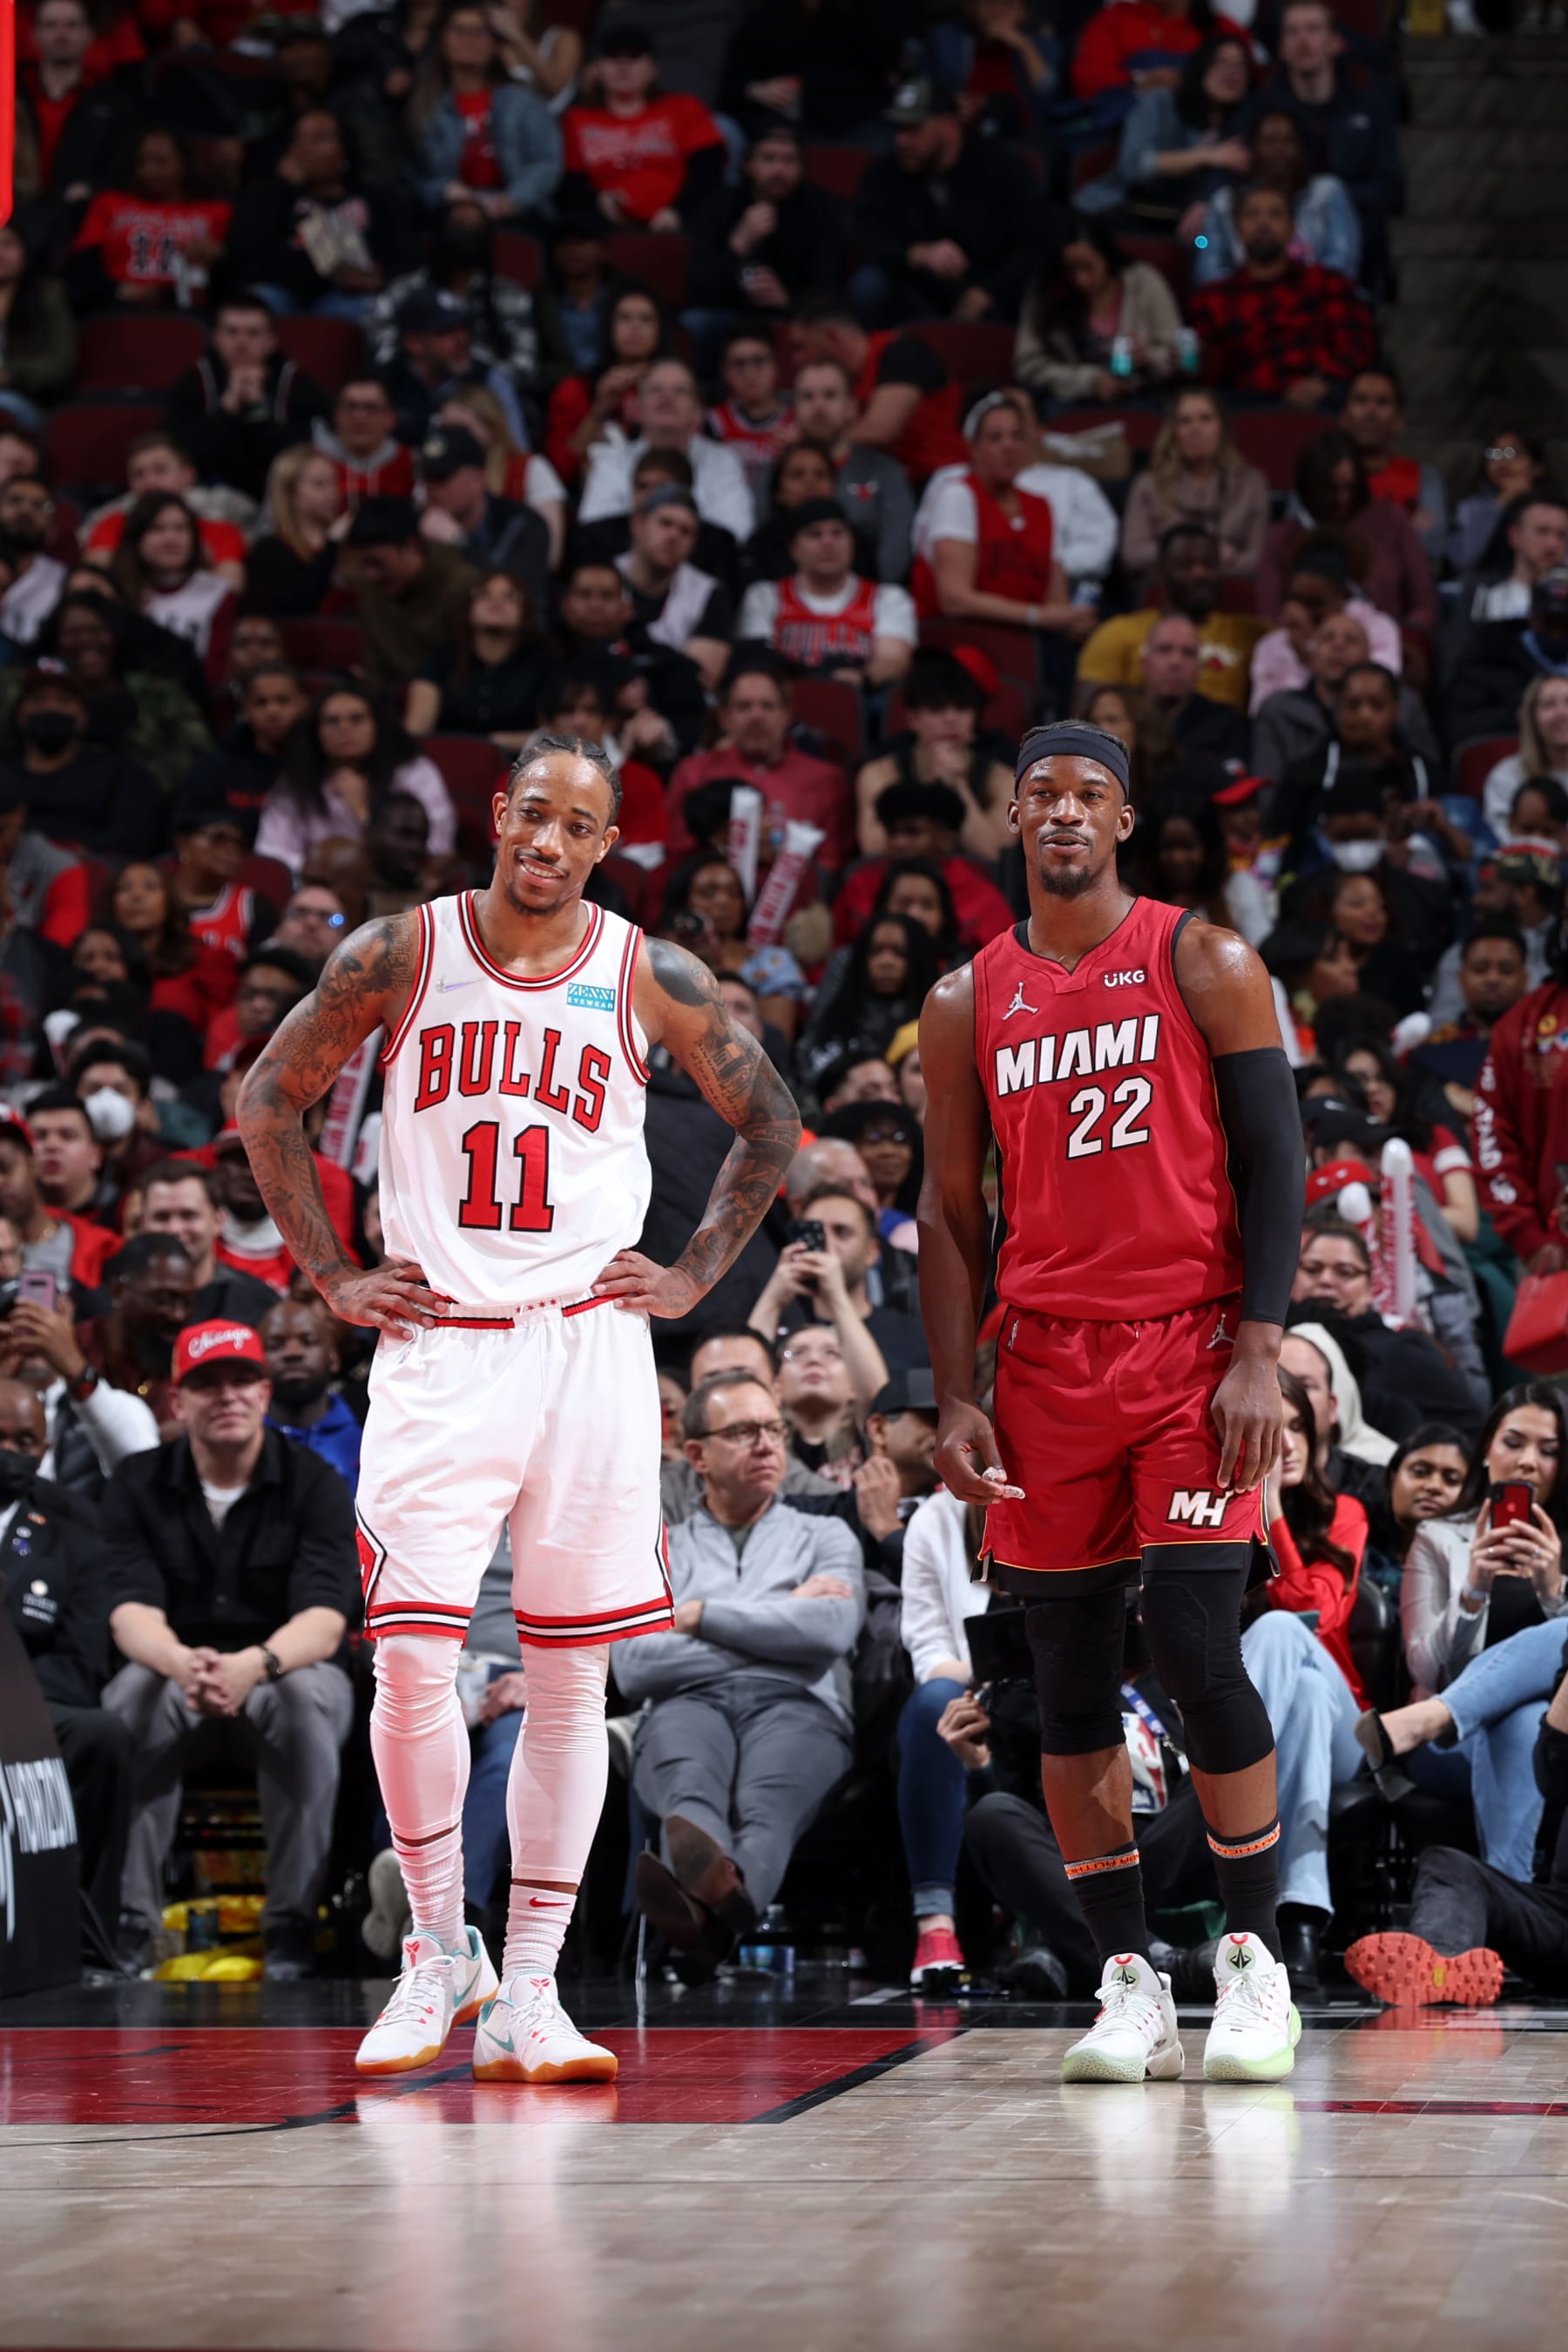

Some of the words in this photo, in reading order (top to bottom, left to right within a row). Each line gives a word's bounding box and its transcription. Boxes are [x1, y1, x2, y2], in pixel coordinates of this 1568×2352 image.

[567, 997, 613, 1009] EYEWEAR
[414, 1020, 612, 1133] BULLS
[994, 1014, 1160, 1097] MIAMI
[1065, 1076, 1153, 1160] 22
[458, 1120, 555, 1232] 11
[187, 1328, 253, 1359] Chicago
